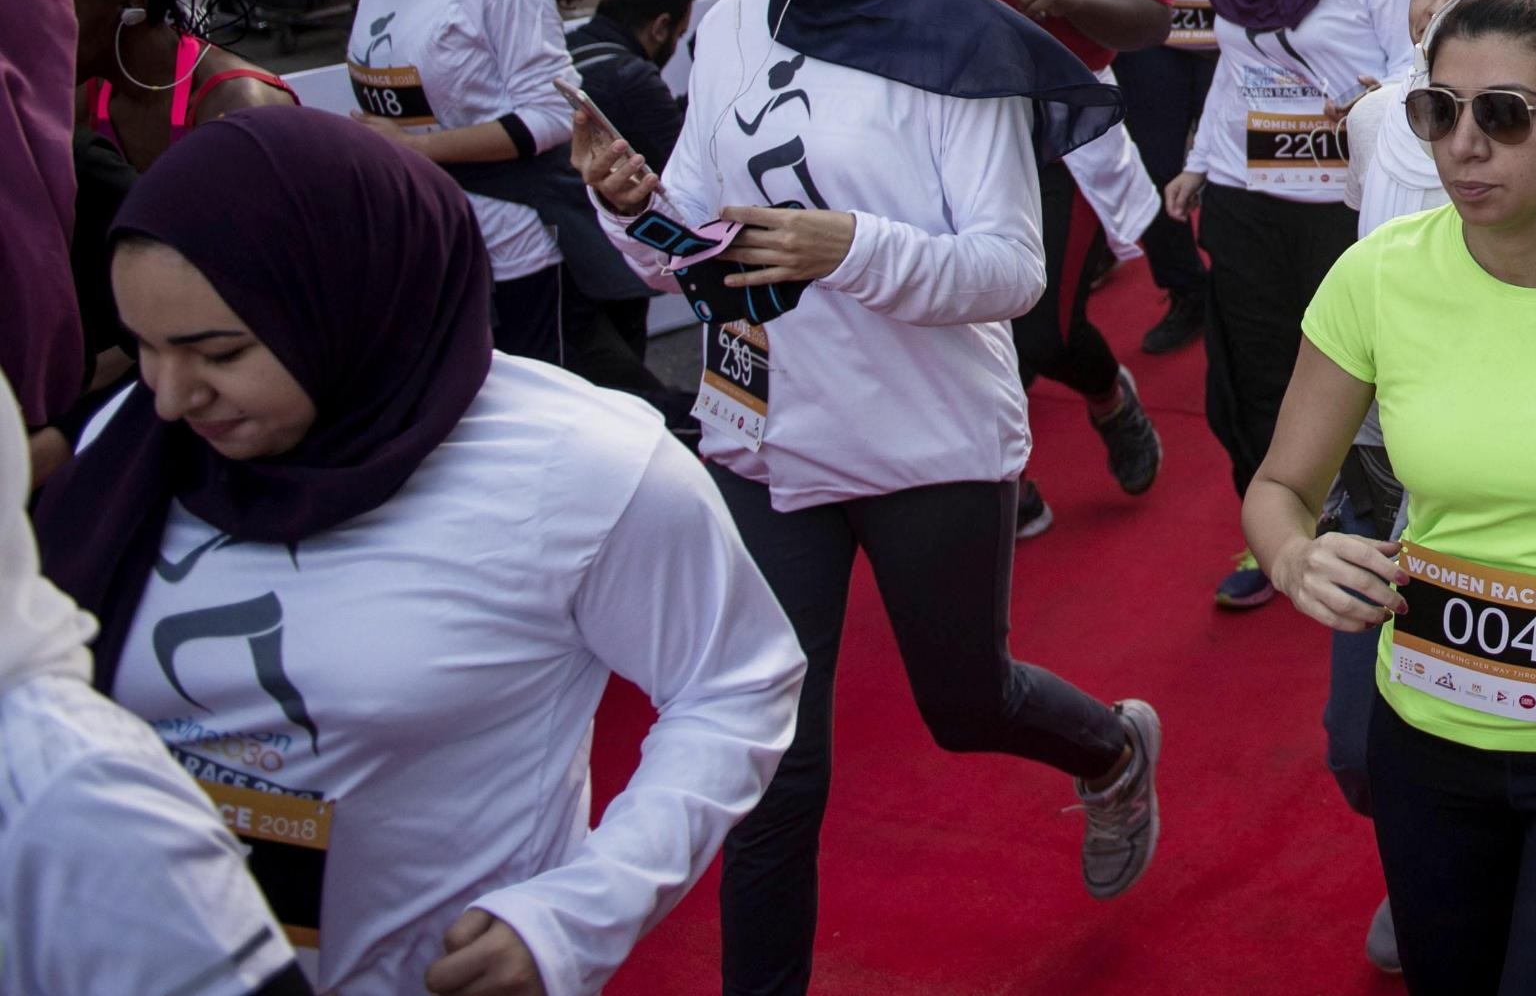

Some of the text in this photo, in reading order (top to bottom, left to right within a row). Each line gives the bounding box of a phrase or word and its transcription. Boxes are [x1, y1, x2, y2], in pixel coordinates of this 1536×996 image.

[362, 86, 403, 116] 118
[1251, 117, 1330, 132] WOMEN RACE
[1274, 133, 1329, 159] 221
[718, 332, 753, 387] 239
[1405, 554, 1485, 595] WOMEN
[1430, 646, 1471, 667] BREAKING
[1472, 659, 1490, 670] HER
[1492, 665, 1511, 677] WAY
[220, 802, 318, 842] CE 2018
